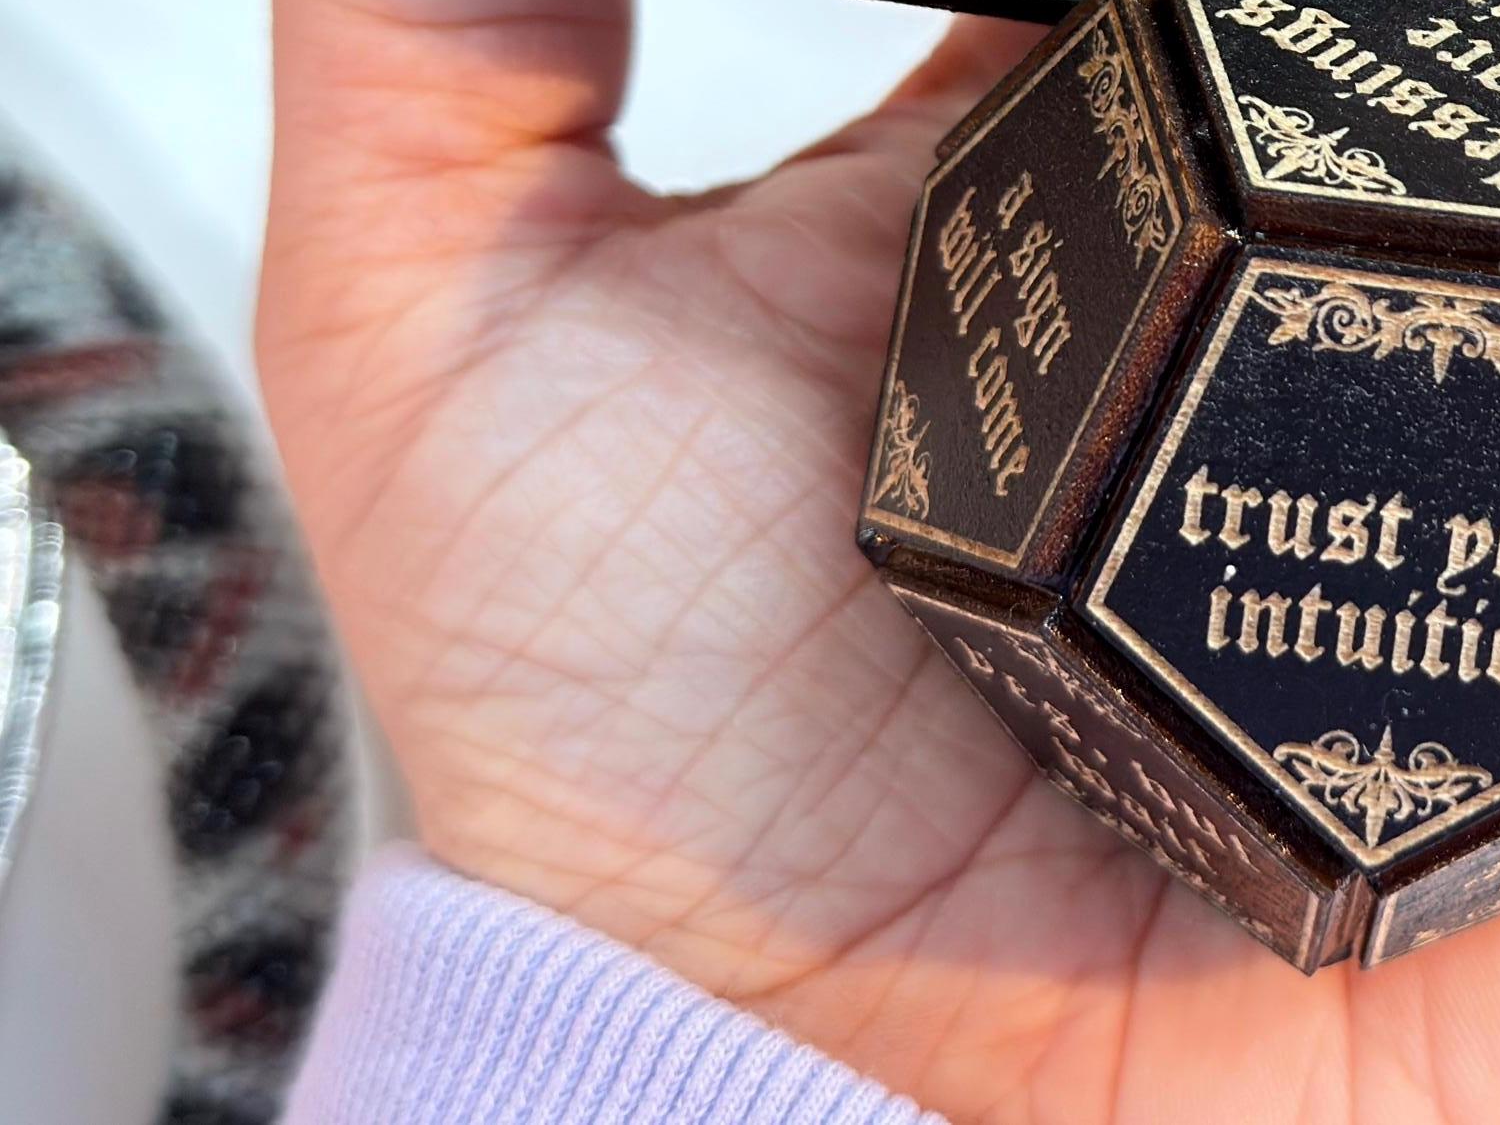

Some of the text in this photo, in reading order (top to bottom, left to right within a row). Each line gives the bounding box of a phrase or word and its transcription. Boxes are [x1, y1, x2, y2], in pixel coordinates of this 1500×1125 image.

[939, 186, 1031, 497] will come
[998, 169, 1072, 375] a sign
[1178, 463, 1413, 570] trust
